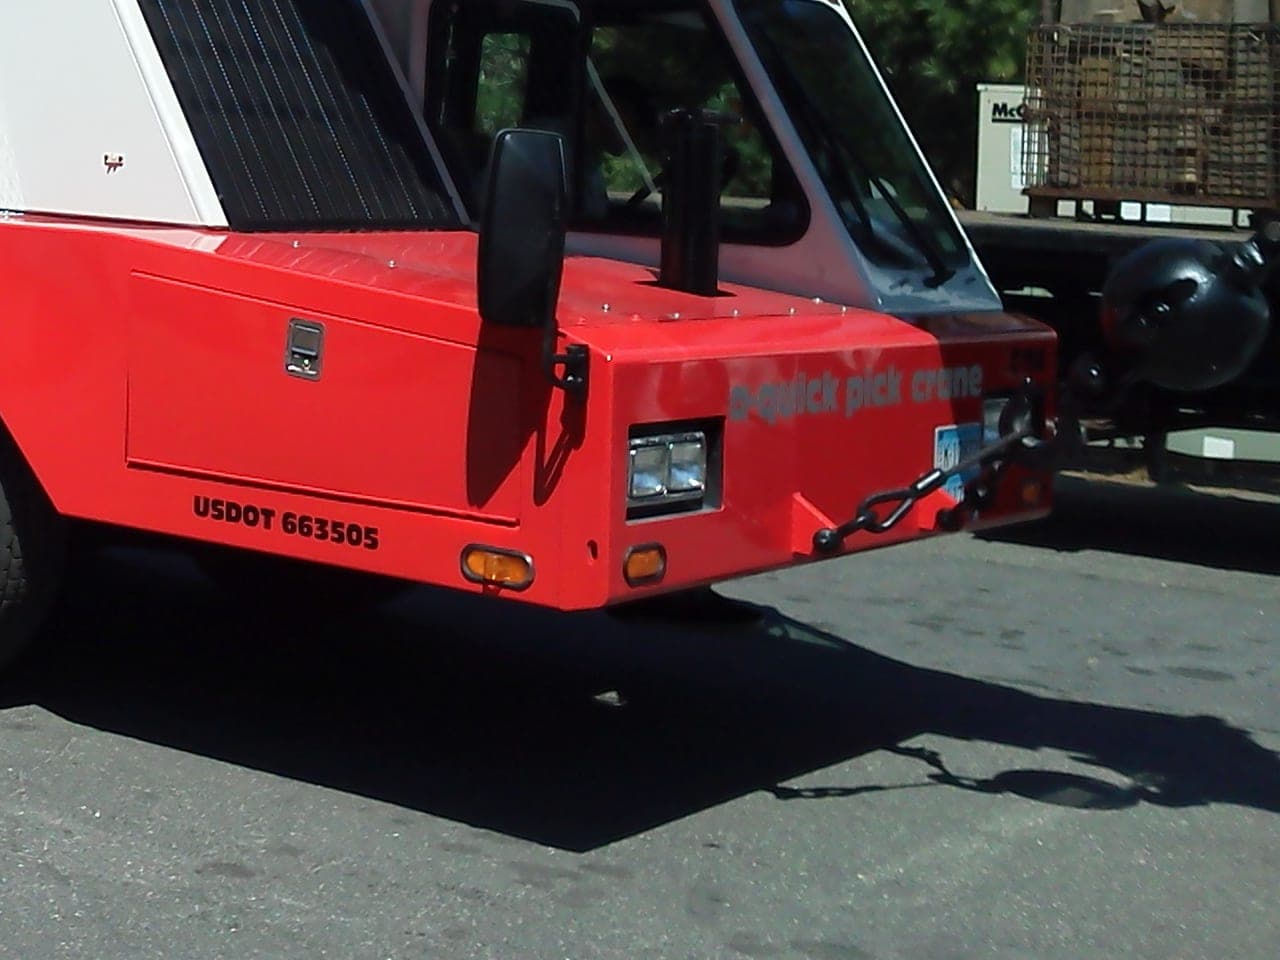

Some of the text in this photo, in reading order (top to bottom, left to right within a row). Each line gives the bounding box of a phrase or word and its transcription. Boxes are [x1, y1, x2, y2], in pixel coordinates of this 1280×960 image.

[729, 364, 984, 426] a-quick pick crane
[193, 495, 380, 551] USDOT 663505
